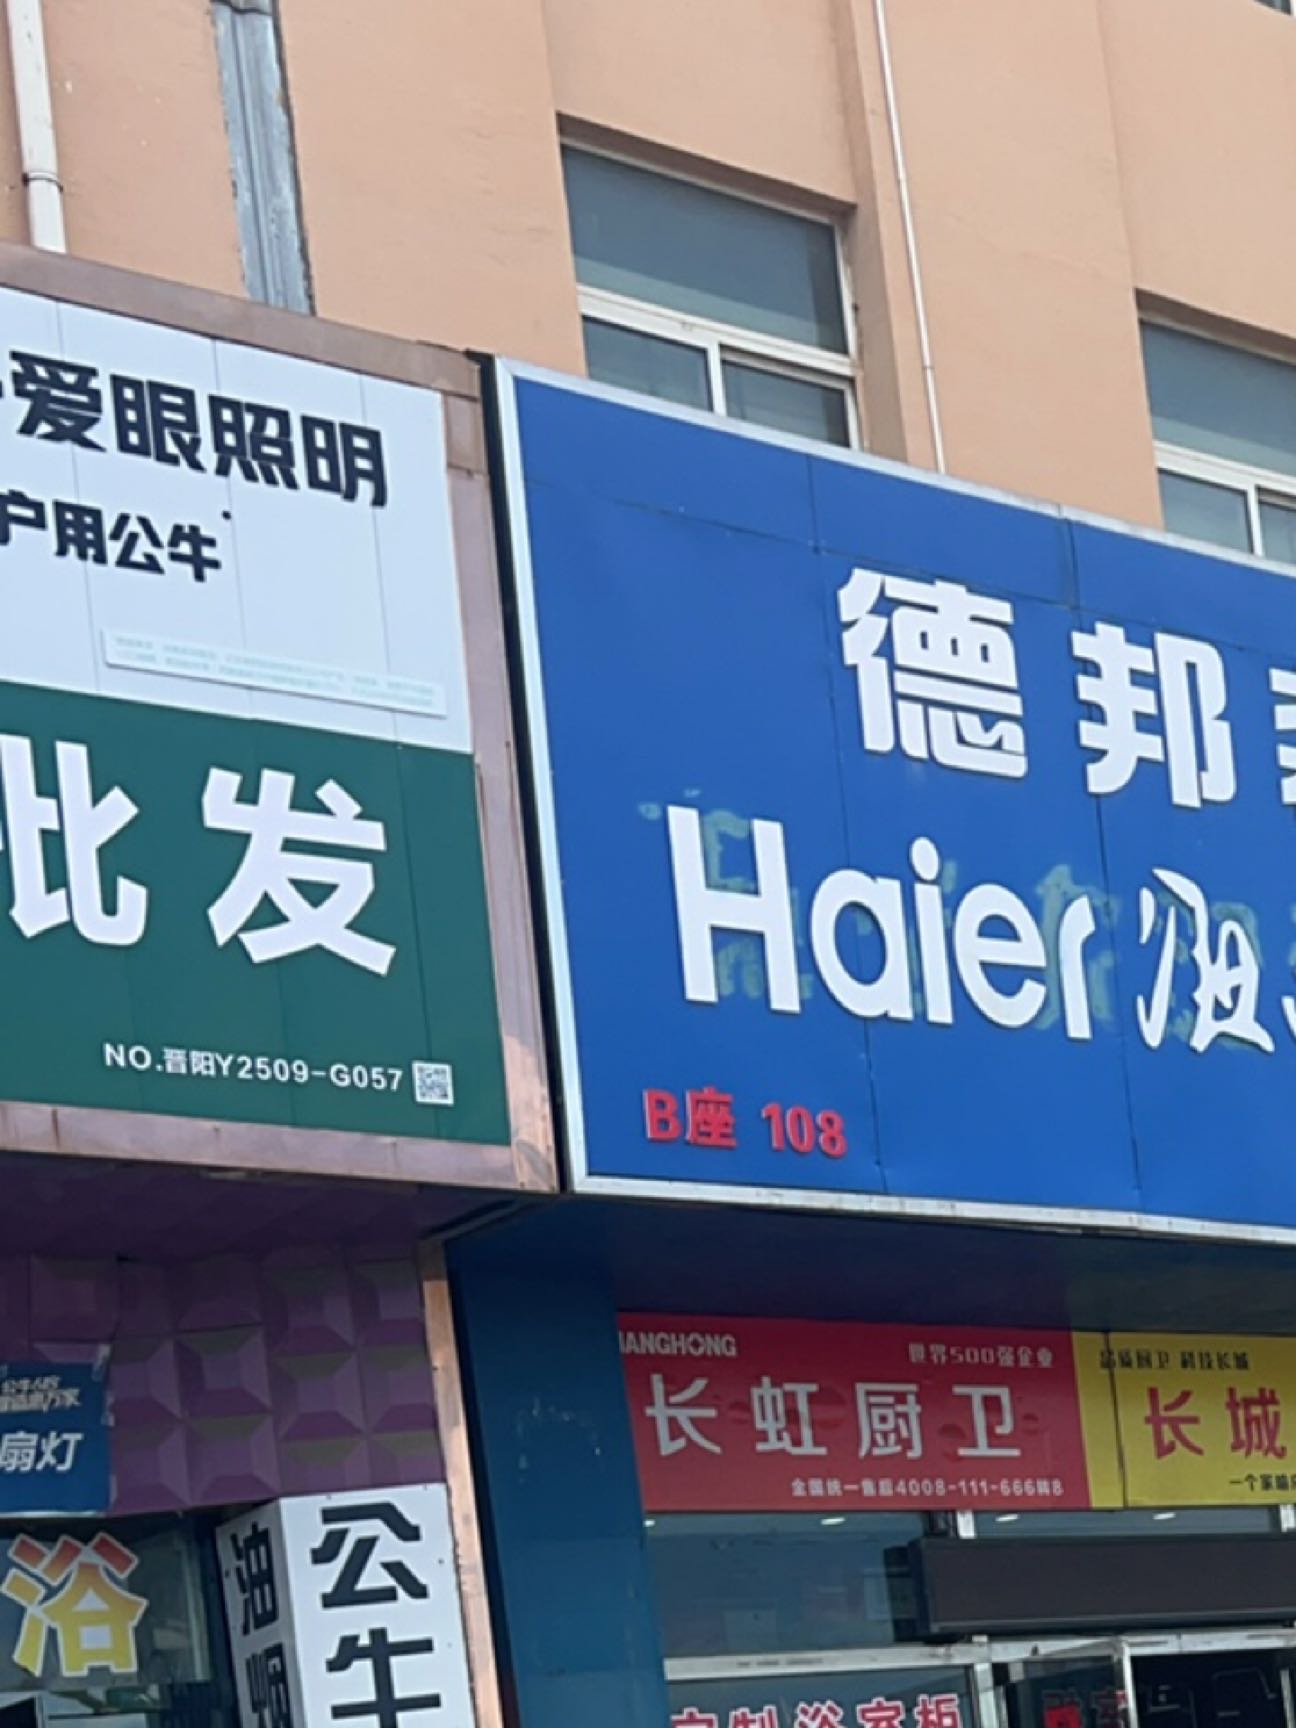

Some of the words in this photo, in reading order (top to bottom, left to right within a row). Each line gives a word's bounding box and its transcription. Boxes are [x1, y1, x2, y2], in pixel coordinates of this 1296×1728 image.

[0, 349, 388, 508] 爱眼照明
[0, 490, 222, 583] 户用公牛
[0, 735, 397, 978] 批发
[667, 804, 1096, 1040] Haier
[103, 1042, 404, 1093] NO.晋阳Y2509-G057
[643, 1087, 738, 1148] B座
[761, 1103, 848, 1158] 108
[645, 1372, 1021, 1460] 长虹厨卫
